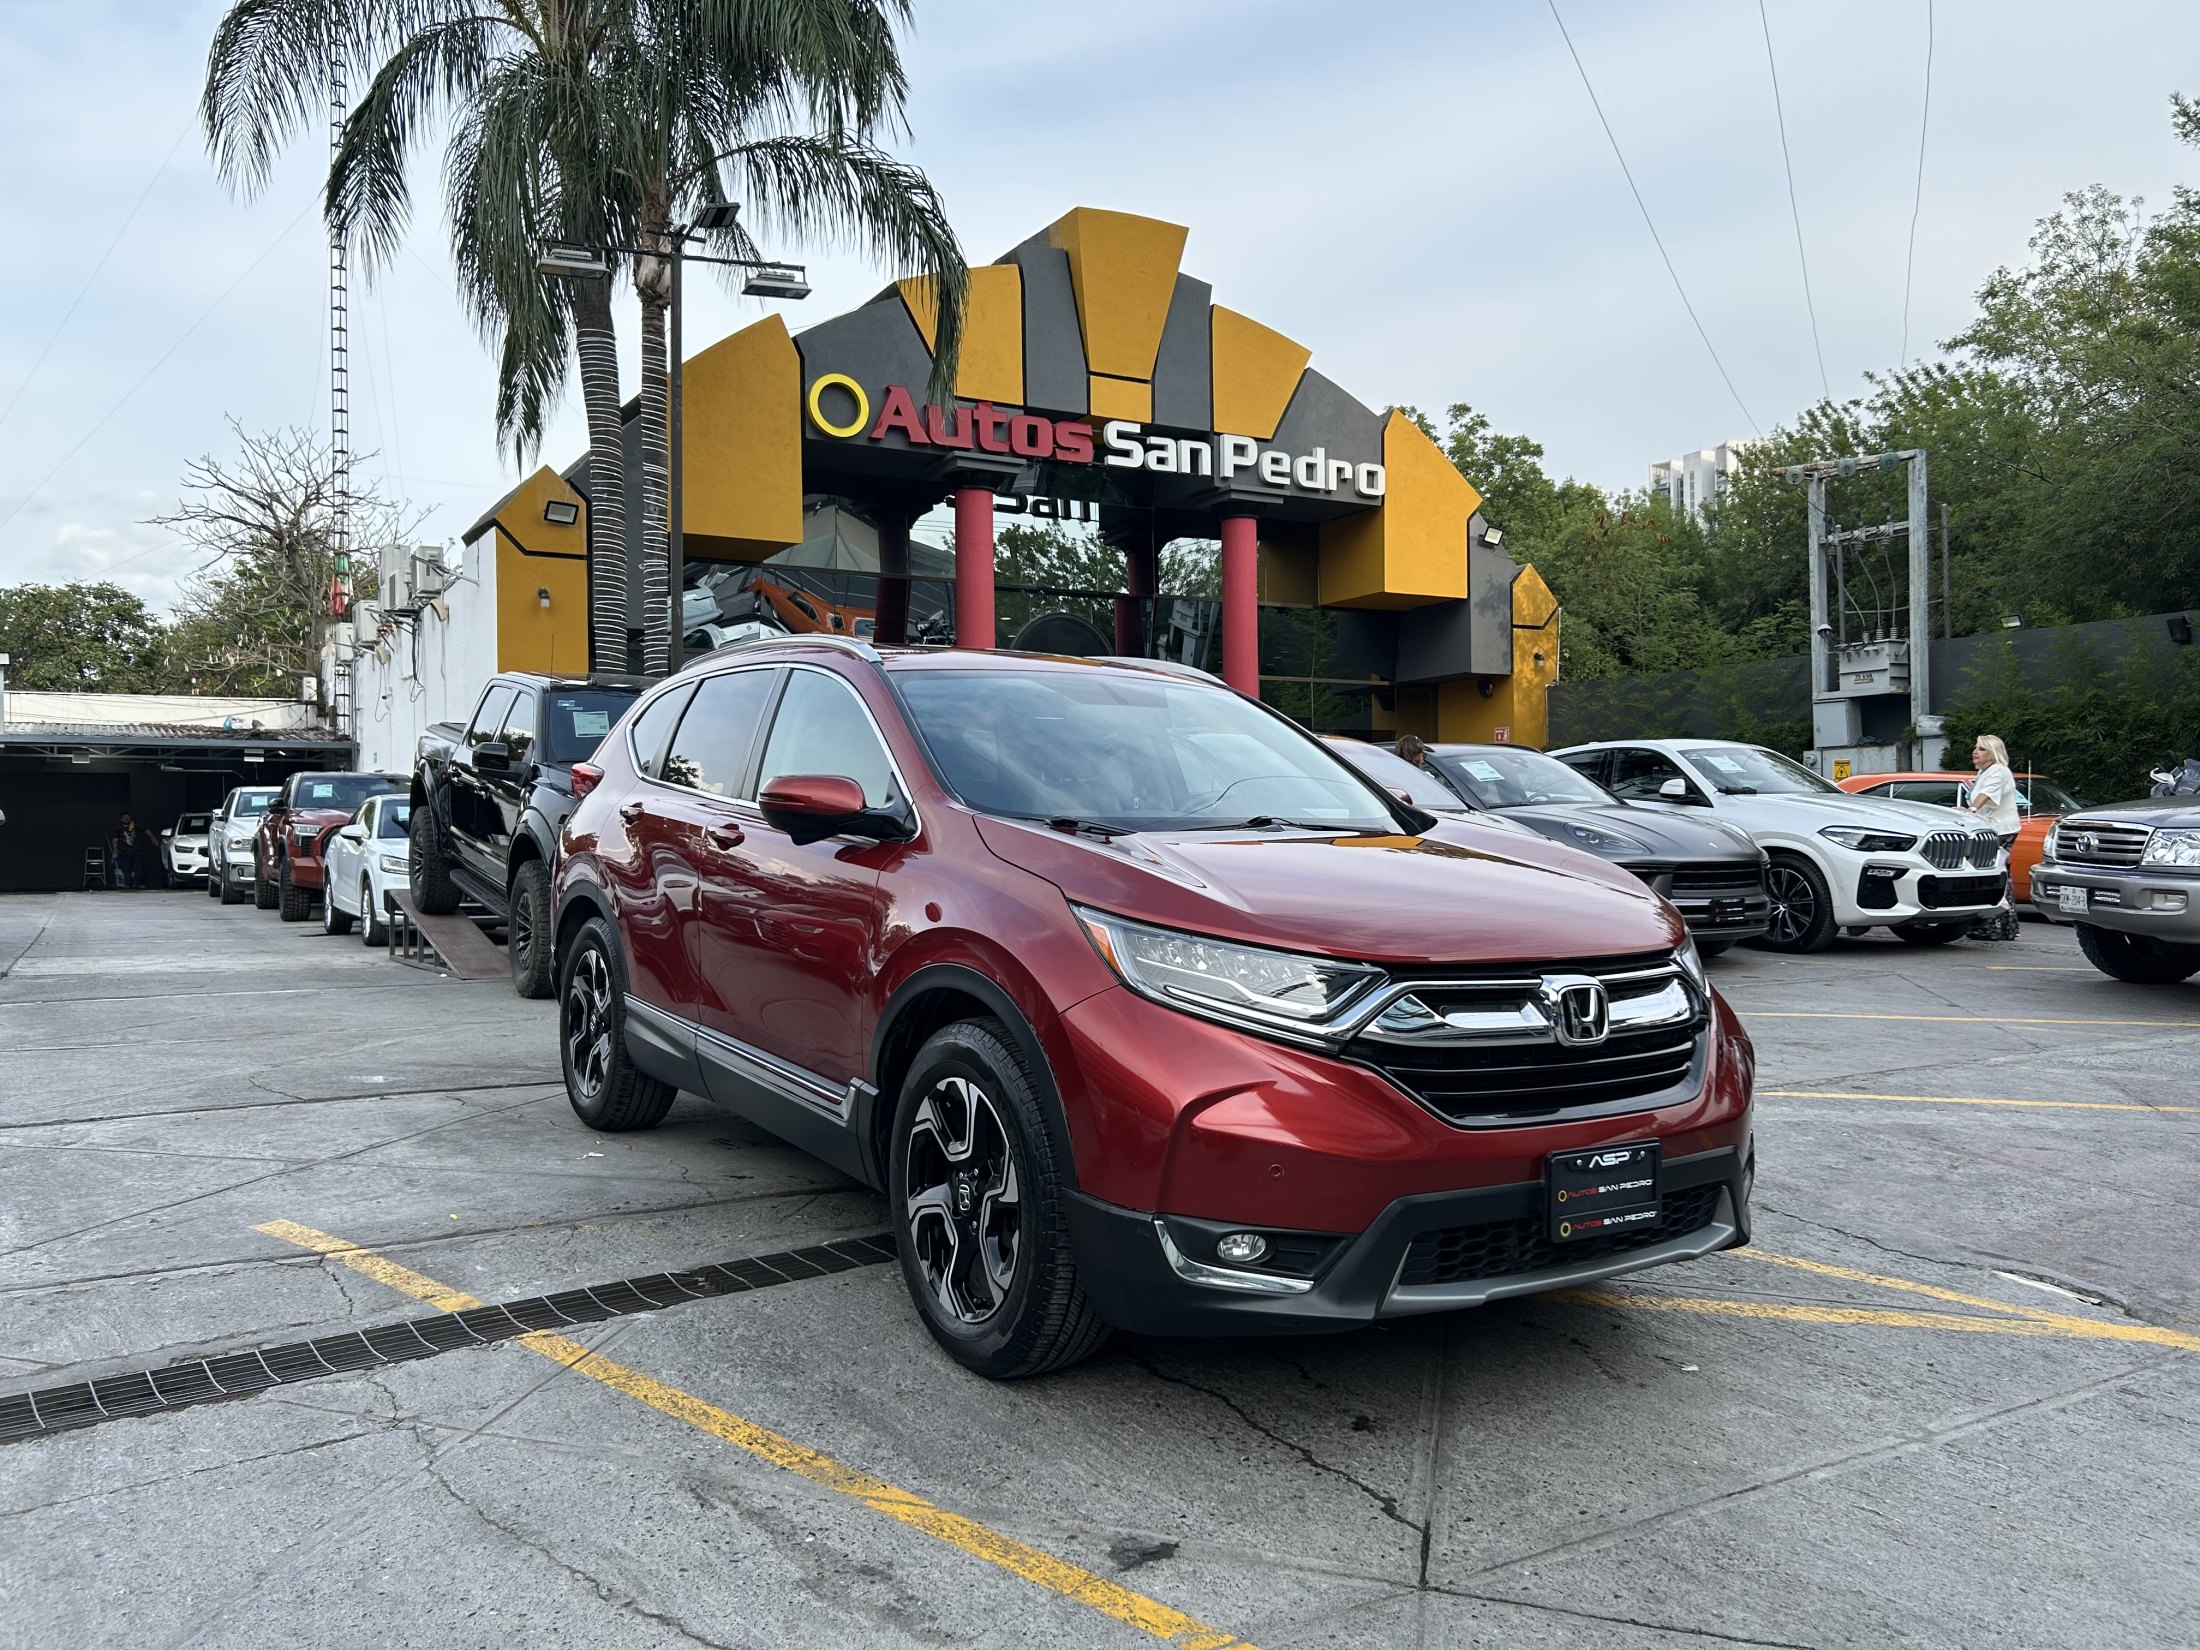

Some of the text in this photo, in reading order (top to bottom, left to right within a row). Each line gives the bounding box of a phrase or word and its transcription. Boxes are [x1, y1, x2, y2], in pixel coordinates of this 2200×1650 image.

[868, 385, 1386, 496] Autos San Pedro
[1589, 1151, 1631, 1168] ASP
[1568, 1179, 1653, 1198] AUTOS SAN PEDRO
[1573, 1211, 1656, 1230] AUTOS SAN PEDRO
